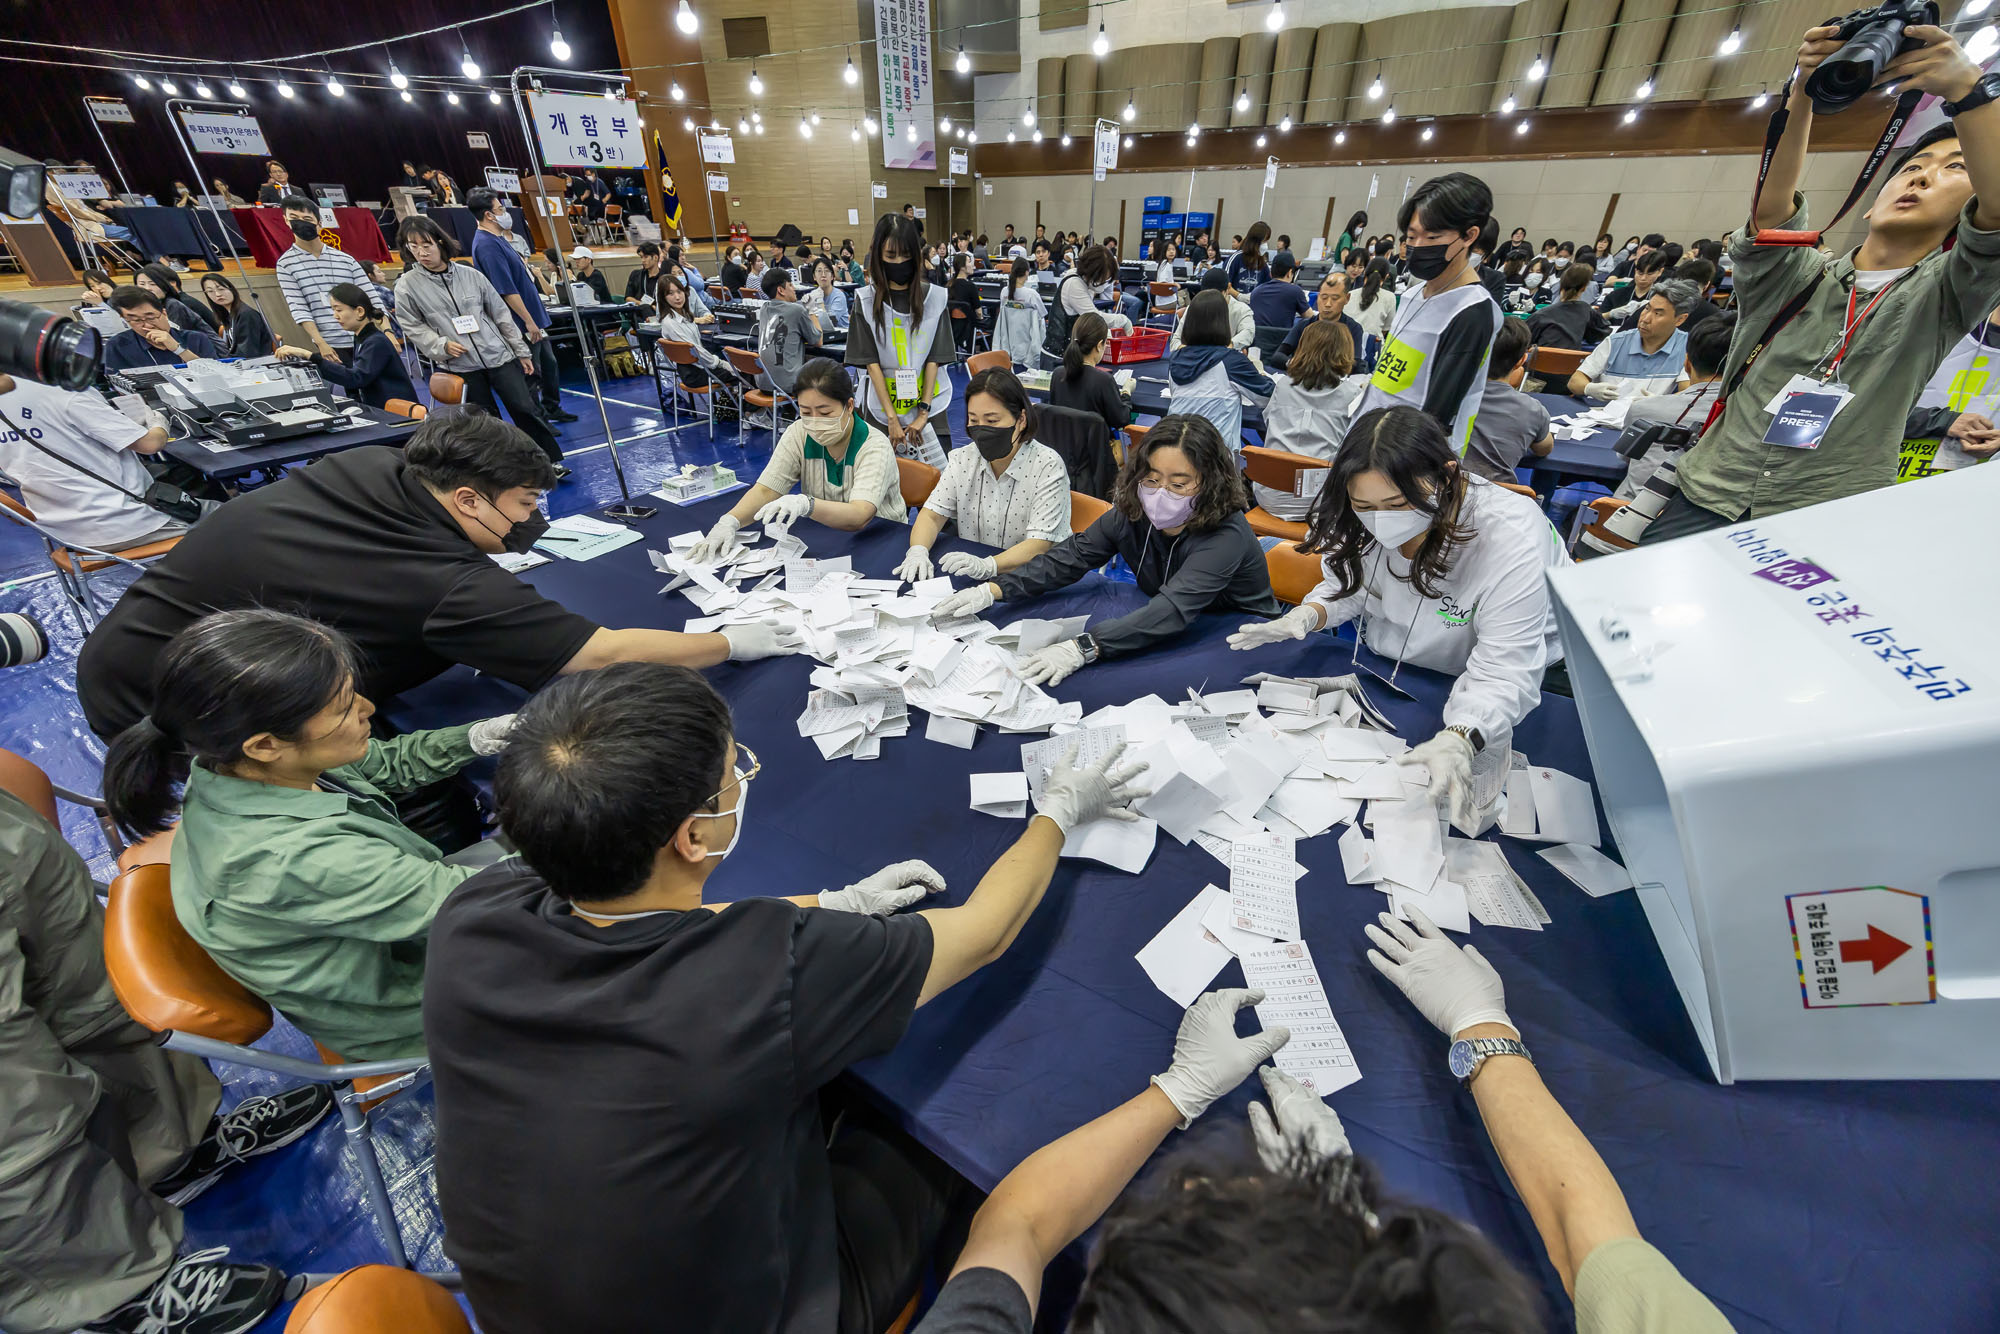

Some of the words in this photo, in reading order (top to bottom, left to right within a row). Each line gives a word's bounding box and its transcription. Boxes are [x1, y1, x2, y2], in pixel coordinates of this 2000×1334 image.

[1878, 9, 1899, 17] Canon
[889, 7, 899, 51] 행복한
[918, 0, 927, 57] 주인되는
[892, 54, 901, 81] 복지
[902, 56, 910, 83] 교육
[911, 44, 919, 72] 경제
[883, 53, 893, 109] 하나되는
[921, 60, 929, 86] 중구
[895, 86, 902, 112] 중구
[904, 87, 912, 112] 중구
[913, 75, 920, 101] 중구
[188, 124, 260, 137] 투표지분류기운영부
[887, 112, 895, 138] 중구
[1883, 118, 1903, 143] EOS
[1876, 143, 1889, 157] R6
[1759, 148, 1772, 182] Canon
[1866, 157, 1880, 174] Mark
[1745, 343, 1763, 365] EOS
[0, 427, 43, 444] UDO
[1778, 416, 1822, 429] PRESS
[1899, 442, 1937, 456] 서있
[1806, 591, 1874, 626] 꽃은
[1851, 627, 1972, 702] 민주주의
[1805, 902, 1830, 929] 주세요
[1811, 932, 1834, 957] 이동해
[1815, 958, 1837, 975] 잡고
[1816, 978, 1840, 1000] 이곳을
